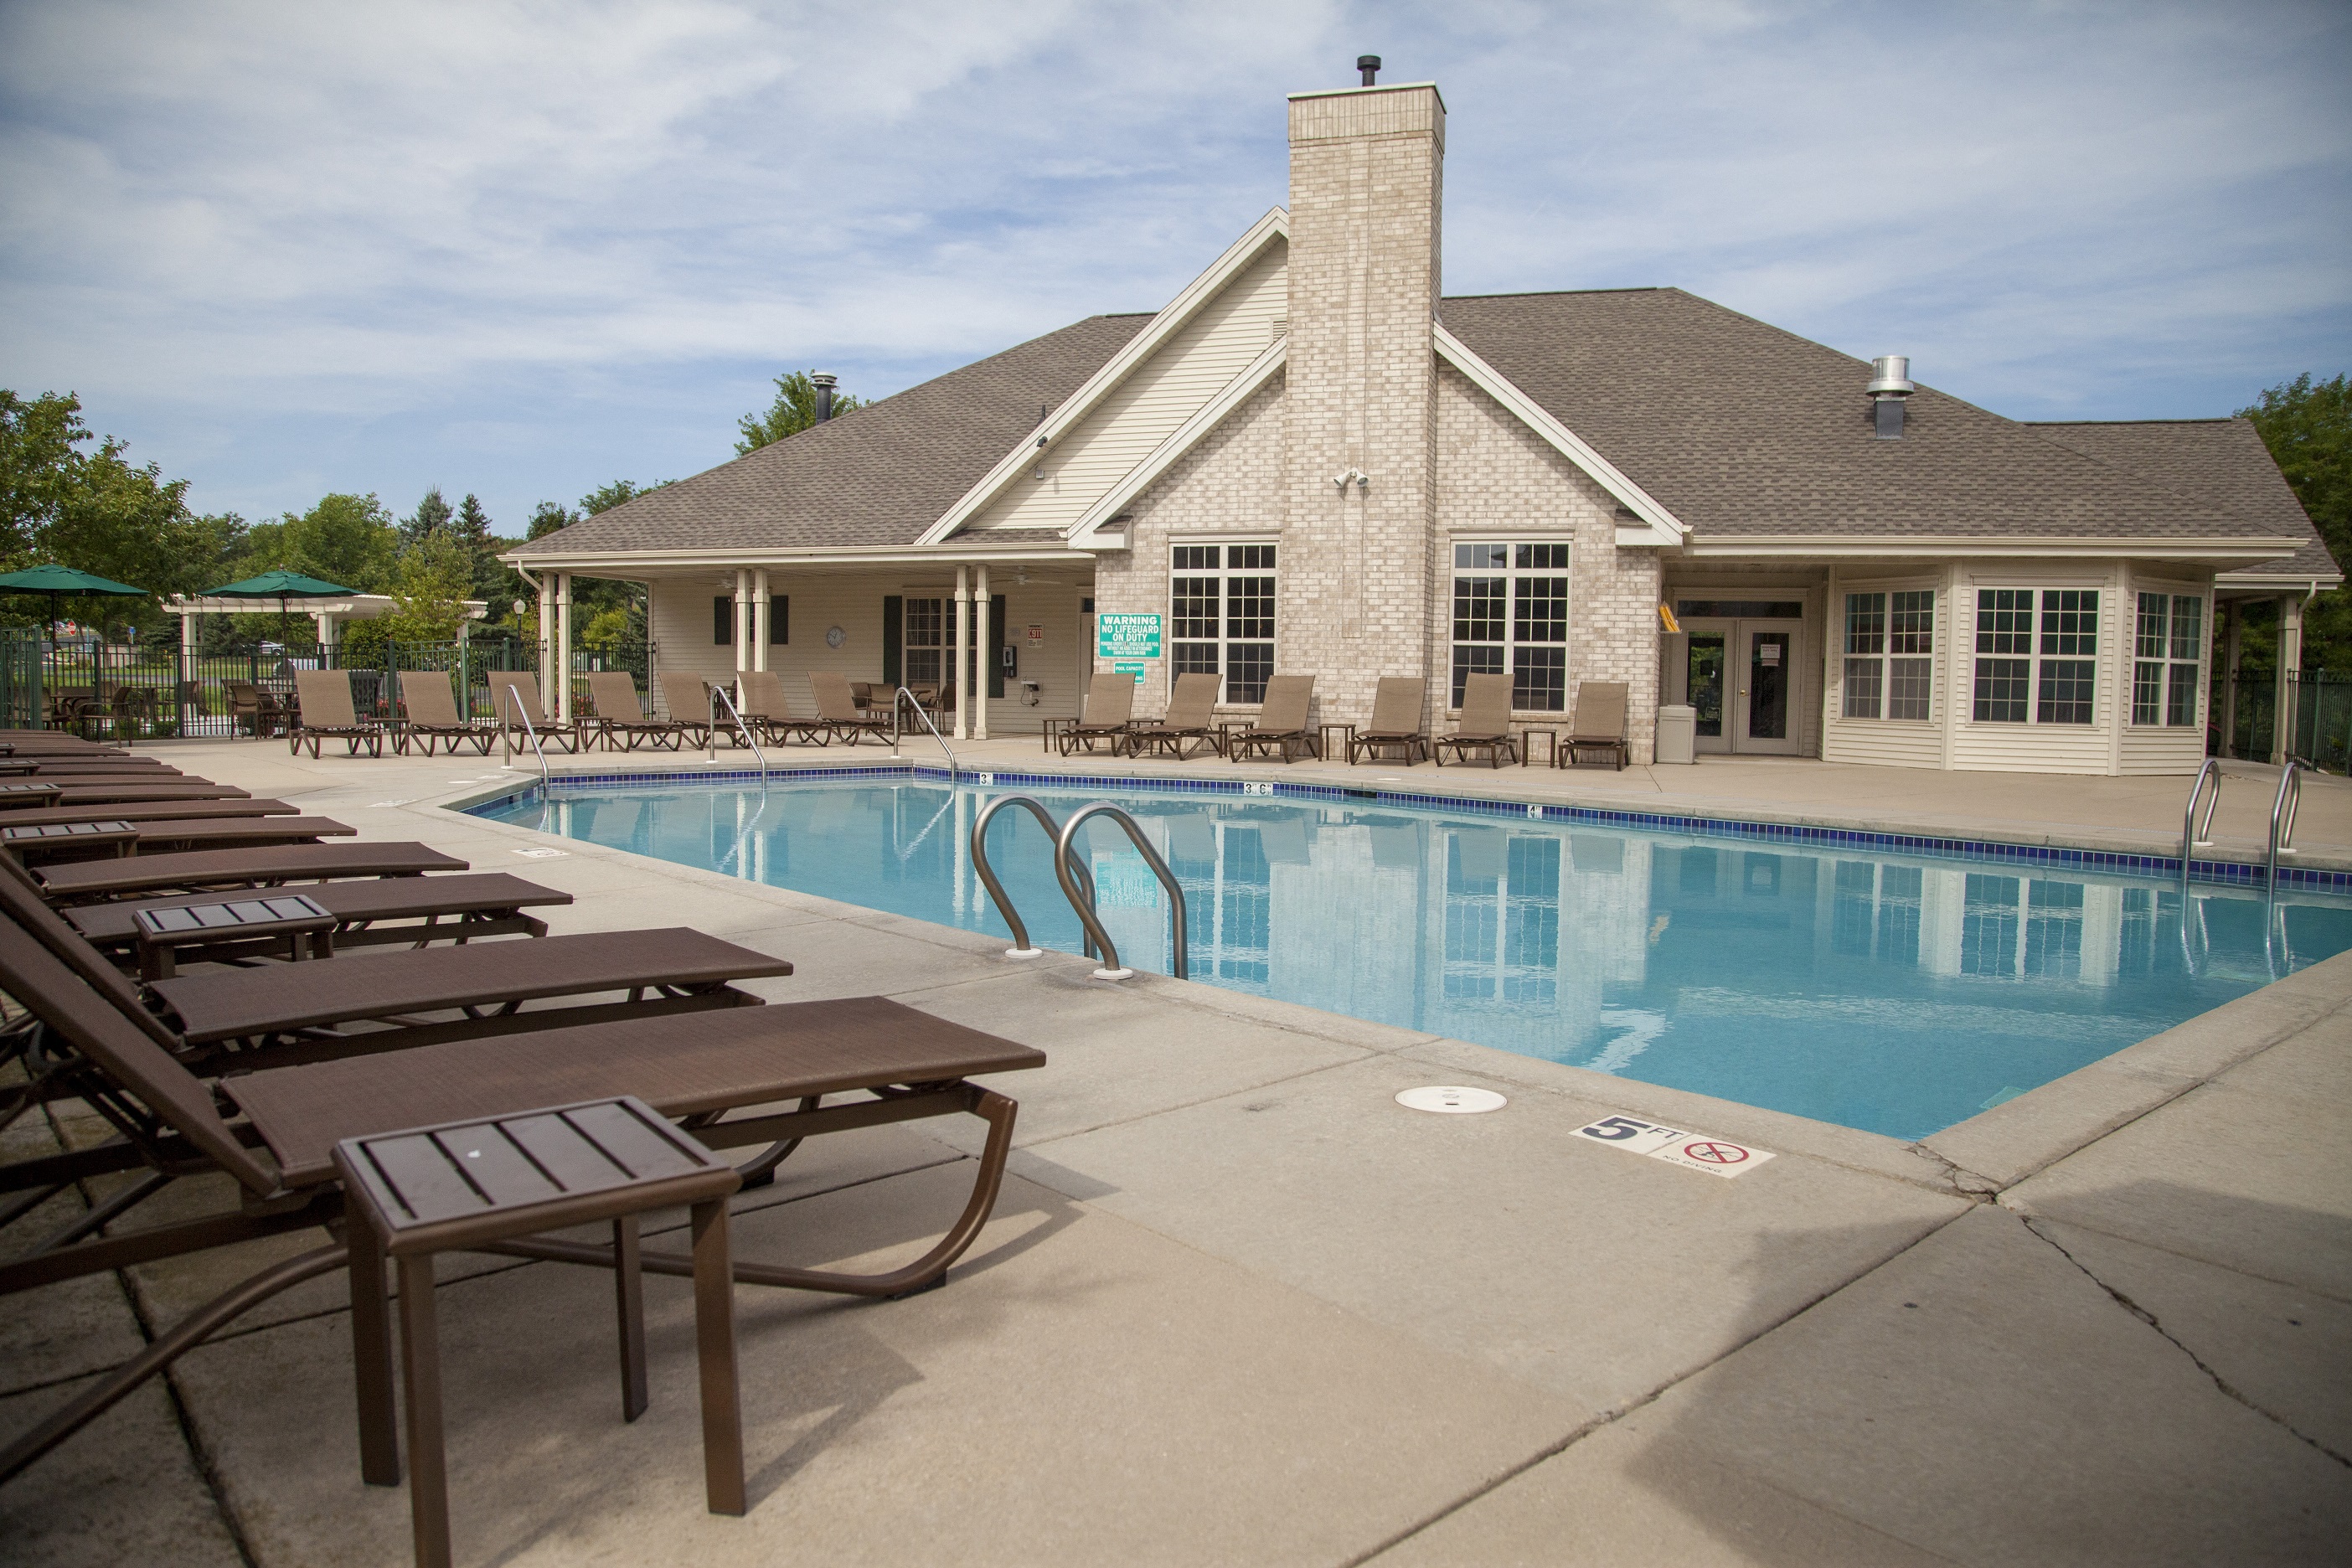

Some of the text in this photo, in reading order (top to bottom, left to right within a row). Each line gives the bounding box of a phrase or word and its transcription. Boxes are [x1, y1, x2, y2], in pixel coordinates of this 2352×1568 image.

[1104, 616, 1158, 625] WARNING
[1101, 625, 1159, 634] NO LIFEGUARD
[1112, 633, 1148, 642] ON DUTY
[1582, 1117, 1684, 1141] 5 FT
[1683, 1160, 1722, 1173] DIVING
